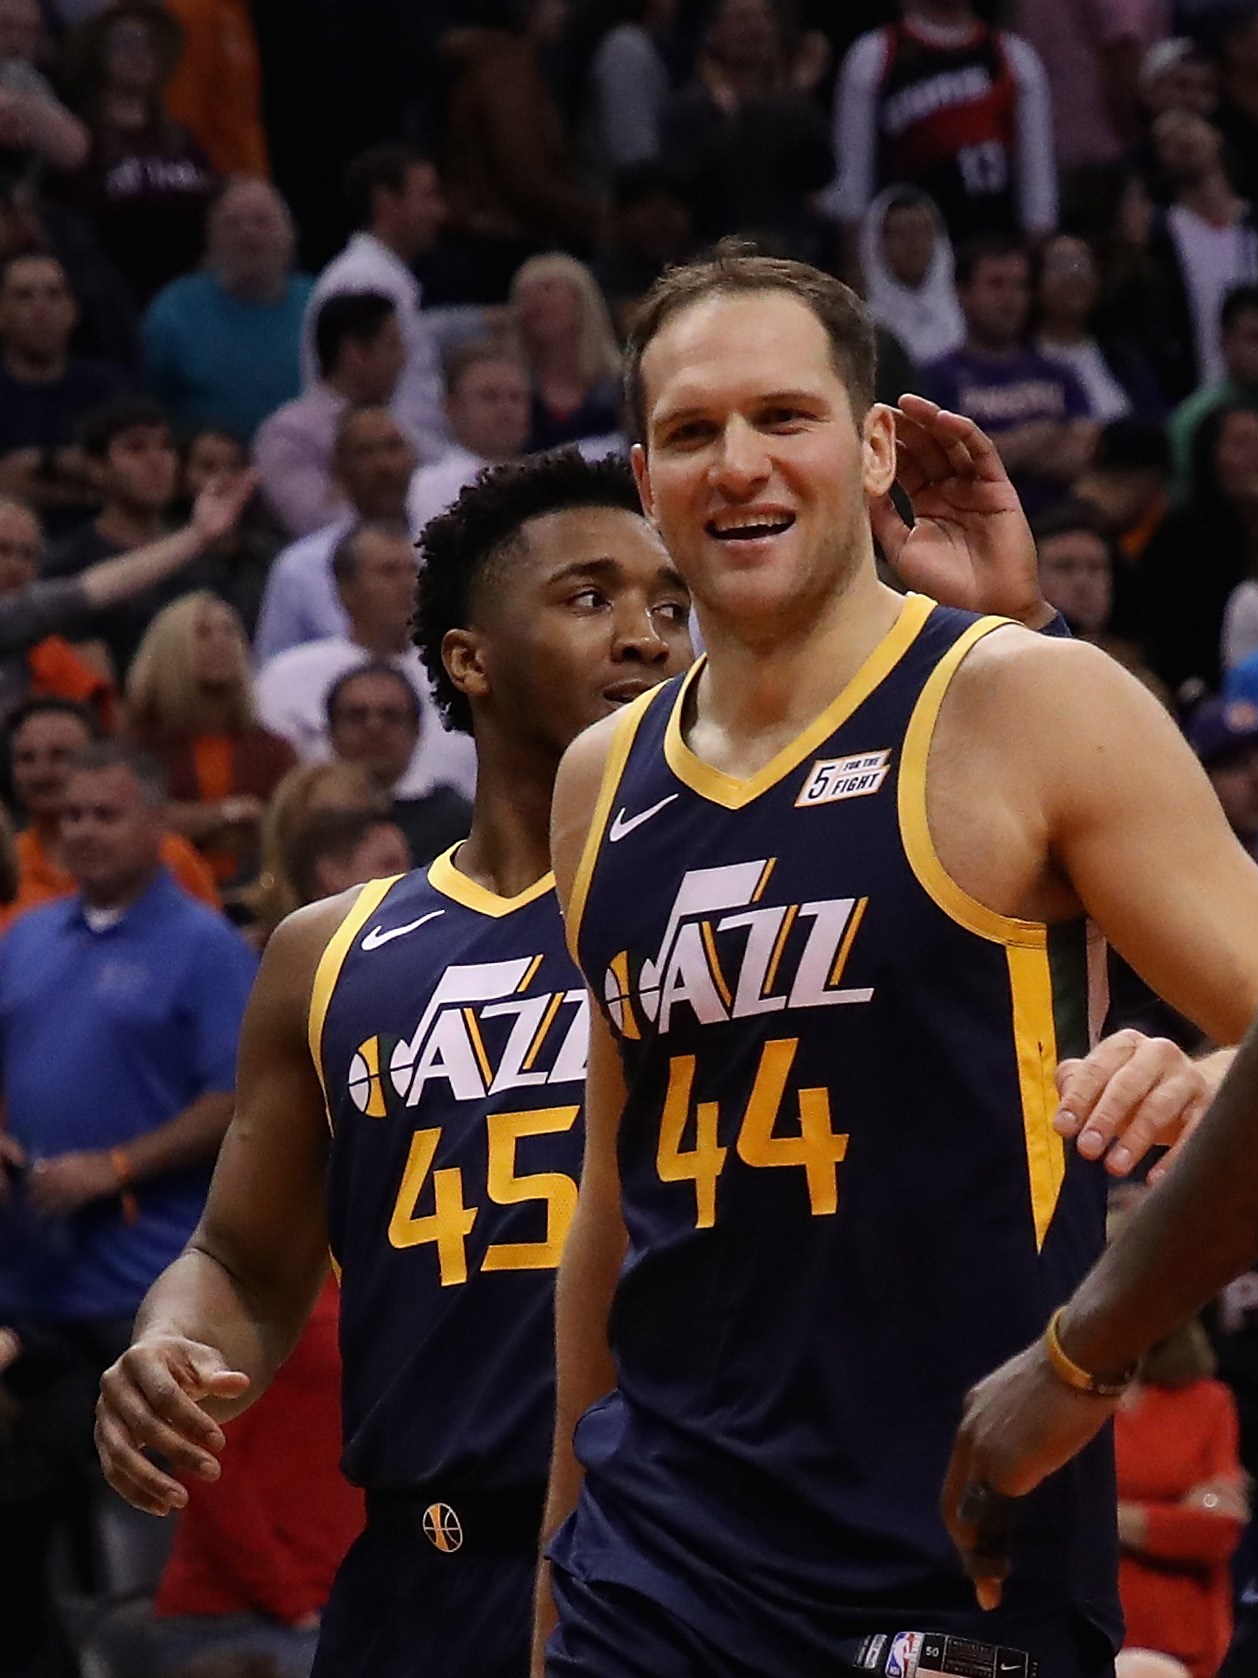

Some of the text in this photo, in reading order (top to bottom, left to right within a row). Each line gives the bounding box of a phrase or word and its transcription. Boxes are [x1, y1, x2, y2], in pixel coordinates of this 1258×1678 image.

[808, 766, 835, 799] 5
[831, 773, 880, 795] FIGHT
[604, 856, 875, 1041] JAZZ
[656, 1037, 850, 1230] 44
[388, 1105, 580, 1287] 45
[925, 1646, 939, 1658] 50
